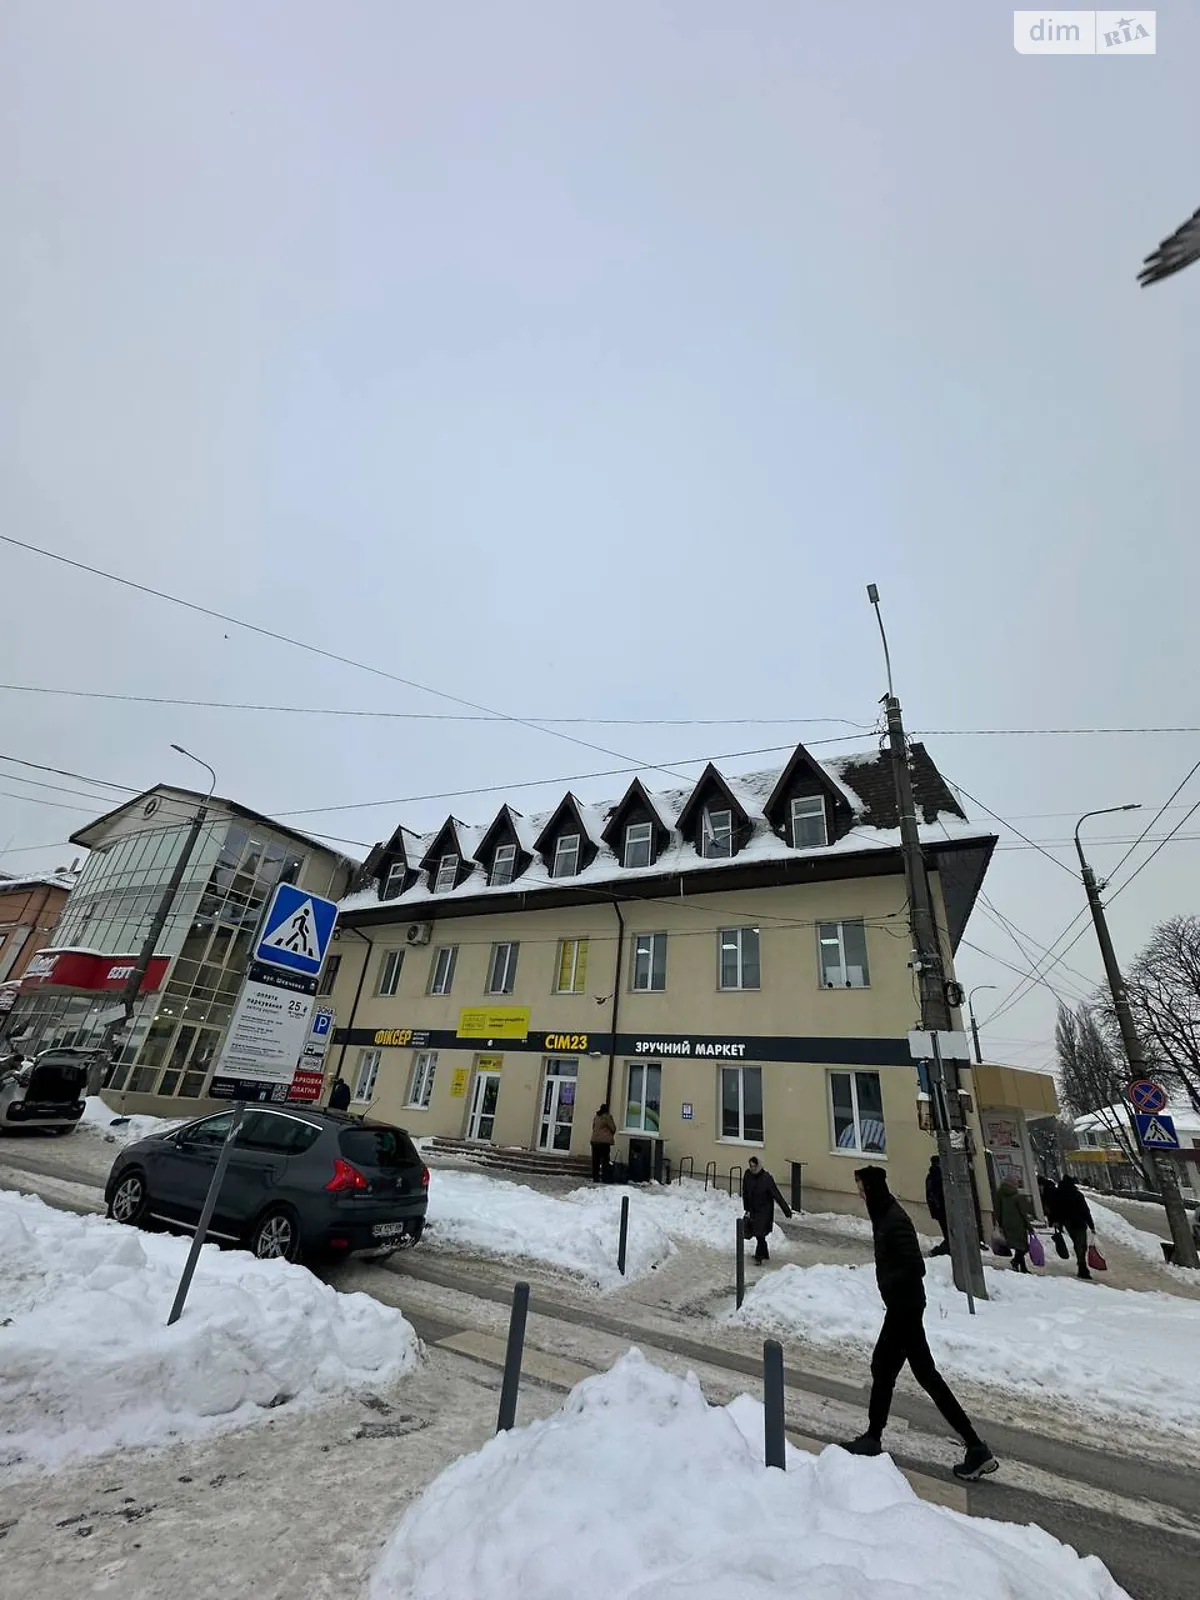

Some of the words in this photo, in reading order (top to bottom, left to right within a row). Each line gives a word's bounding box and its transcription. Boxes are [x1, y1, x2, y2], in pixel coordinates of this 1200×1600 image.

[288, 1000, 302, 1011] 25
[375, 1029, 412, 1046] ФІКСЕР
[545, 1034, 588, 1050] СІМ23
[635, 1040, 690, 1055] ЗРУЧНИЙ
[695, 1043, 746, 1056] МАРКЕТ
[294, 1076, 322, 1085] АРКОВКА
